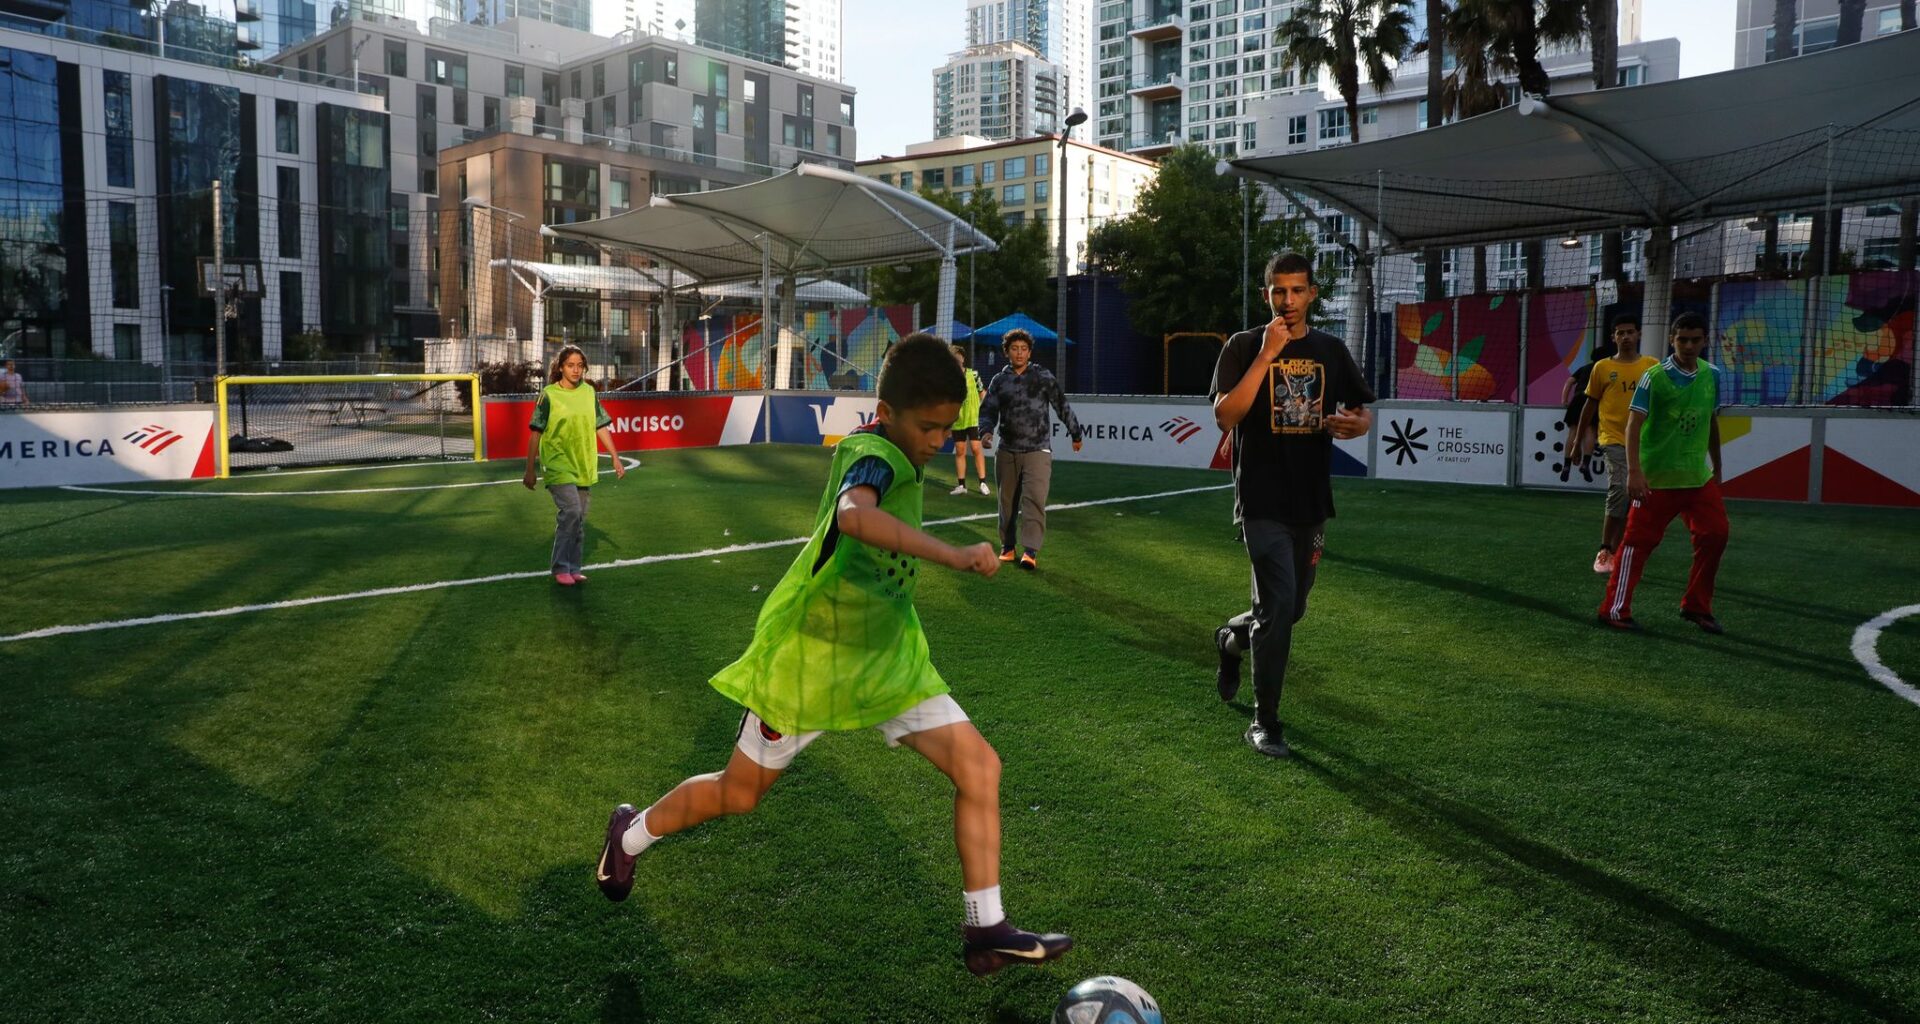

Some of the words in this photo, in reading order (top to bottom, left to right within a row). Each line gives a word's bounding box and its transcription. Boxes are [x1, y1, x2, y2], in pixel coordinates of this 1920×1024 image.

[1622, 381, 1636, 392] 14
[1052, 423, 1060, 437] F
[1438, 427, 1463, 439] THE
[1437, 441, 1504, 455] CROSSING
